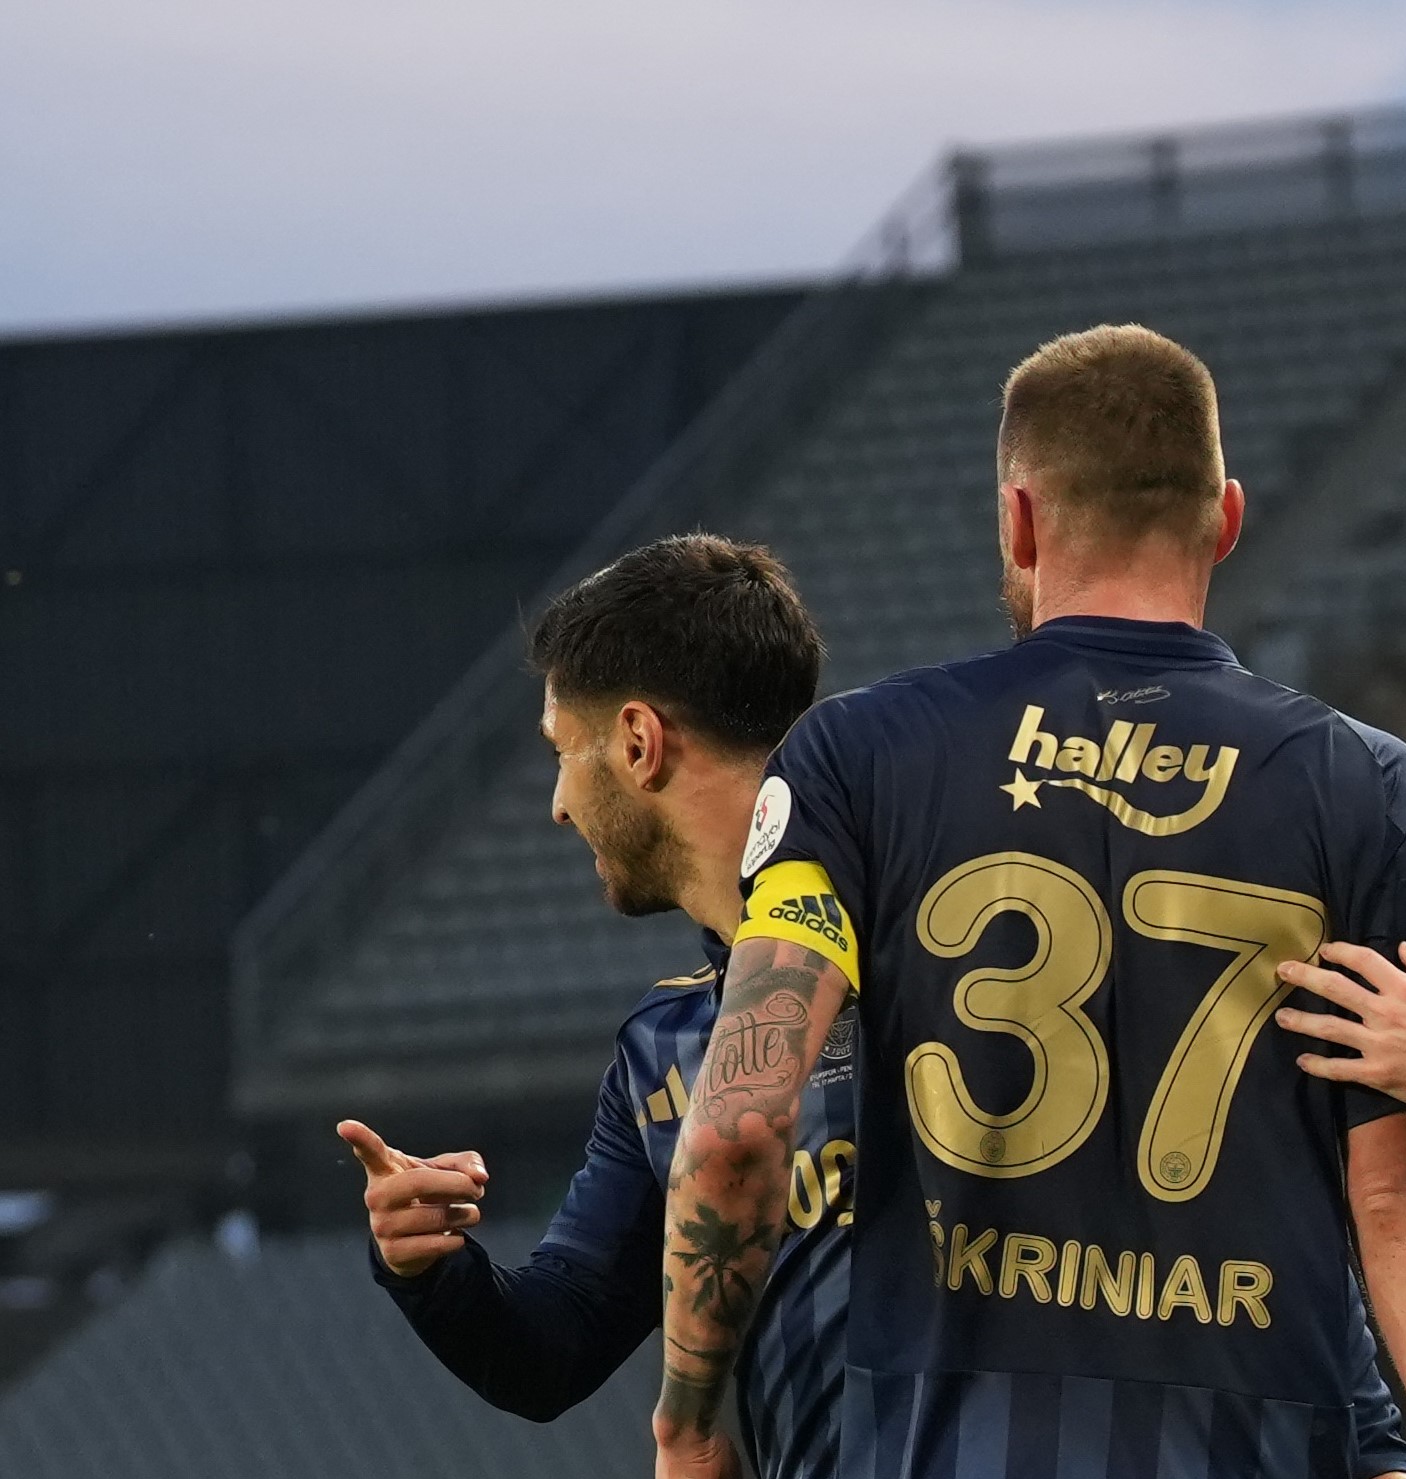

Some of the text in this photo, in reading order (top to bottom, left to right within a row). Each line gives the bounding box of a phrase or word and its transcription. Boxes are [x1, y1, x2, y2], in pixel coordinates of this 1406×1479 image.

[1003, 704, 1240, 836] halley
[768, 904, 849, 953] adidas
[905, 851, 1326, 1203] 37
